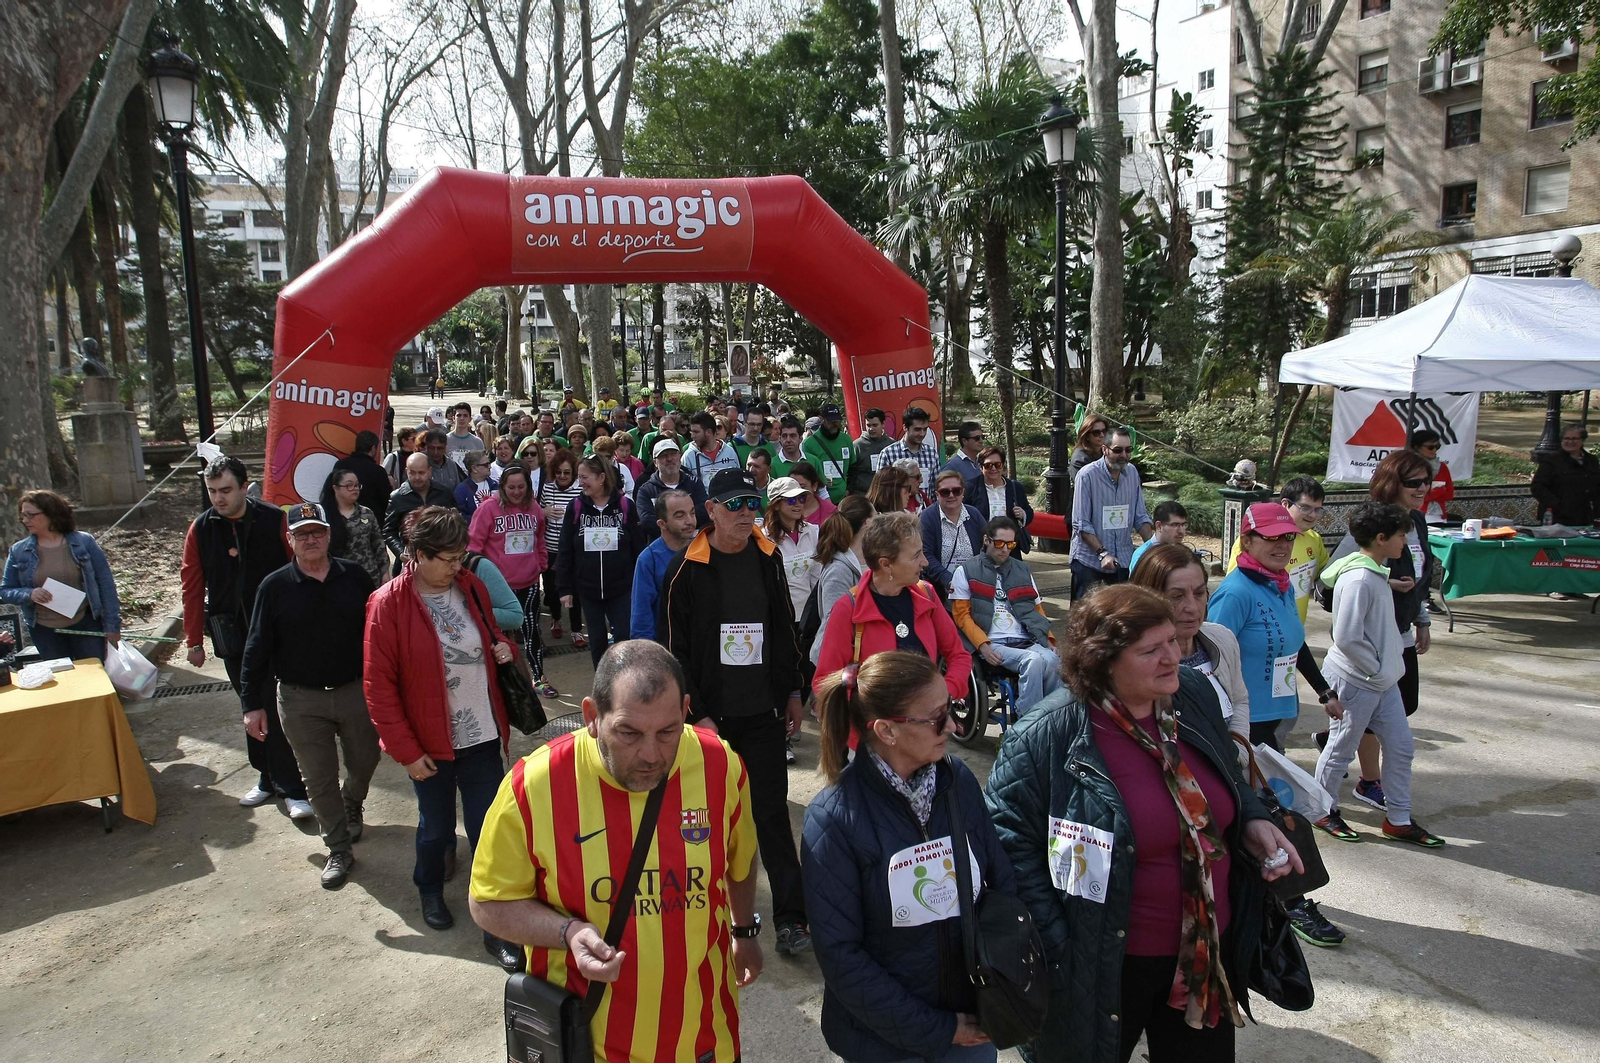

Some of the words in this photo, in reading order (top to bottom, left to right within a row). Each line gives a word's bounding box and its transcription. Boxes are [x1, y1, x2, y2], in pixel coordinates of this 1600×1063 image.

[524, 187, 741, 240] animagic
[526, 233, 561, 248] con
[571, 228, 587, 247] el
[861, 365, 937, 393] animag
[275, 378, 382, 417] animagic
[1350, 460, 1379, 468] Asociaci
[1367, 449, 1393, 461] AD
[914, 841, 944, 855] MARCHA
[889, 859, 913, 873] TODOS
[915, 851, 941, 864] SOMOS
